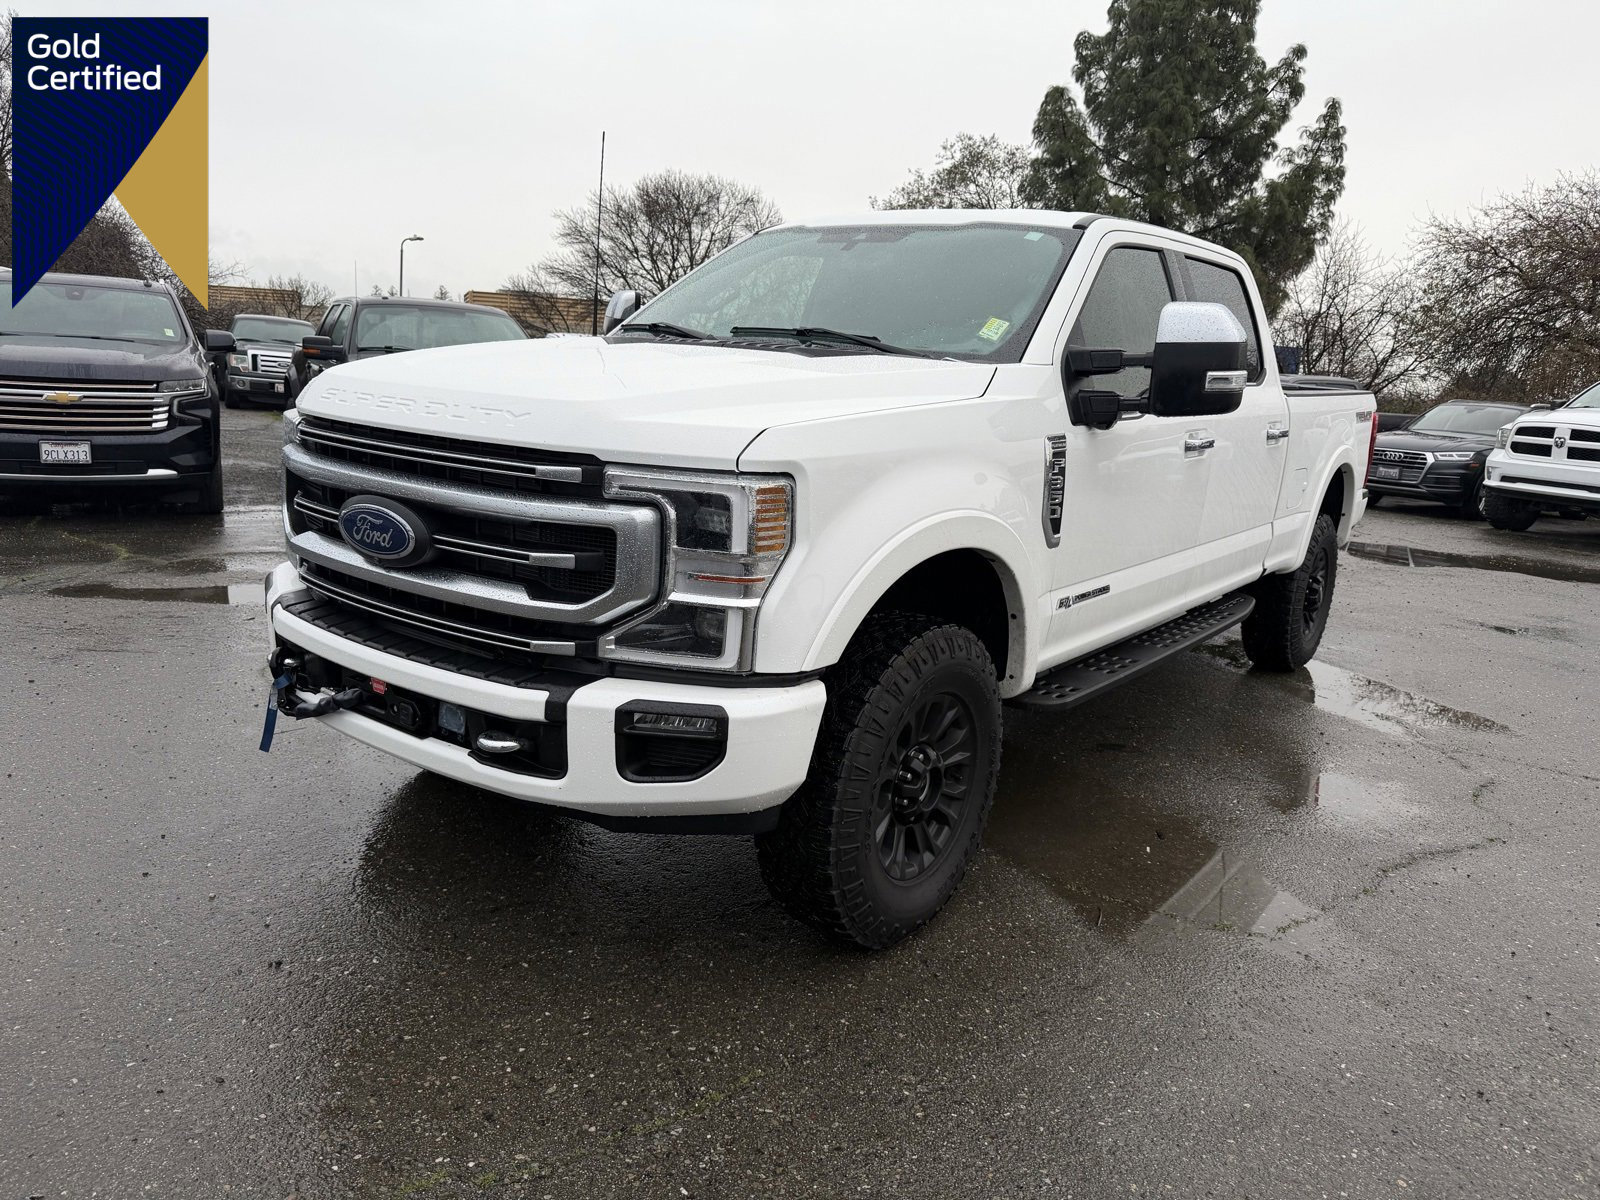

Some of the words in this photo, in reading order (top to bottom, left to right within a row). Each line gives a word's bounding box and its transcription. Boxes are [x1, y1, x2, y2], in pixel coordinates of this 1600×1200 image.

[320, 387, 417, 414] SUPER
[420, 400, 532, 427] DUTY
[353, 514, 393, 548] Ford
